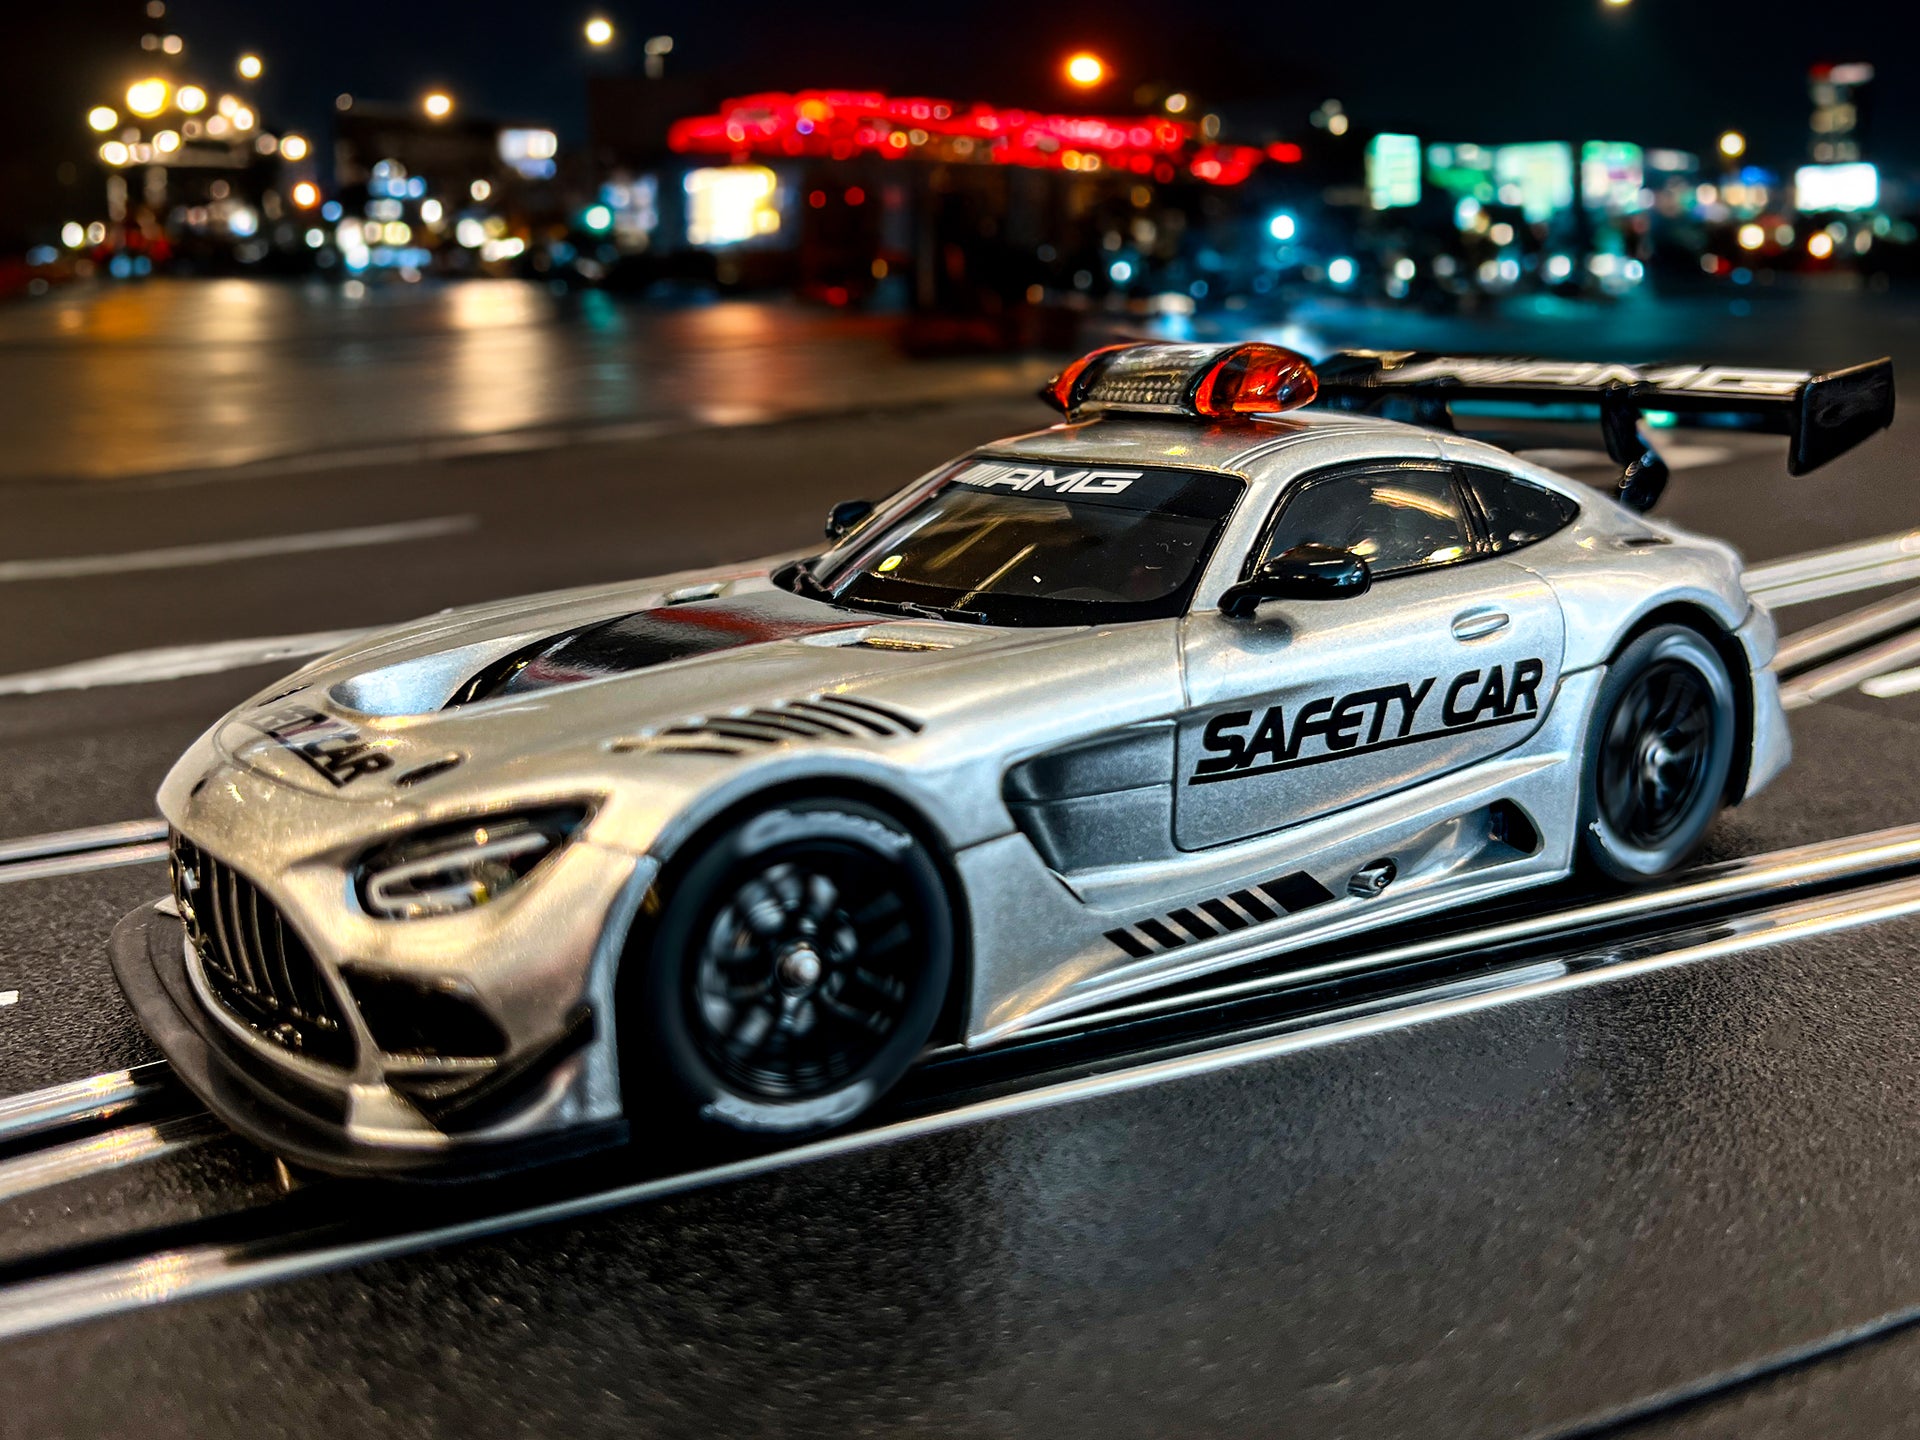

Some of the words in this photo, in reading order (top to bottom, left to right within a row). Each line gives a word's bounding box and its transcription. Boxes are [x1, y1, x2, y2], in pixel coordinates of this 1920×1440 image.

[984, 466, 1143, 494] AMG
[1194, 678, 1436, 775] SAFETY
[1442, 658, 1543, 727] CAR
